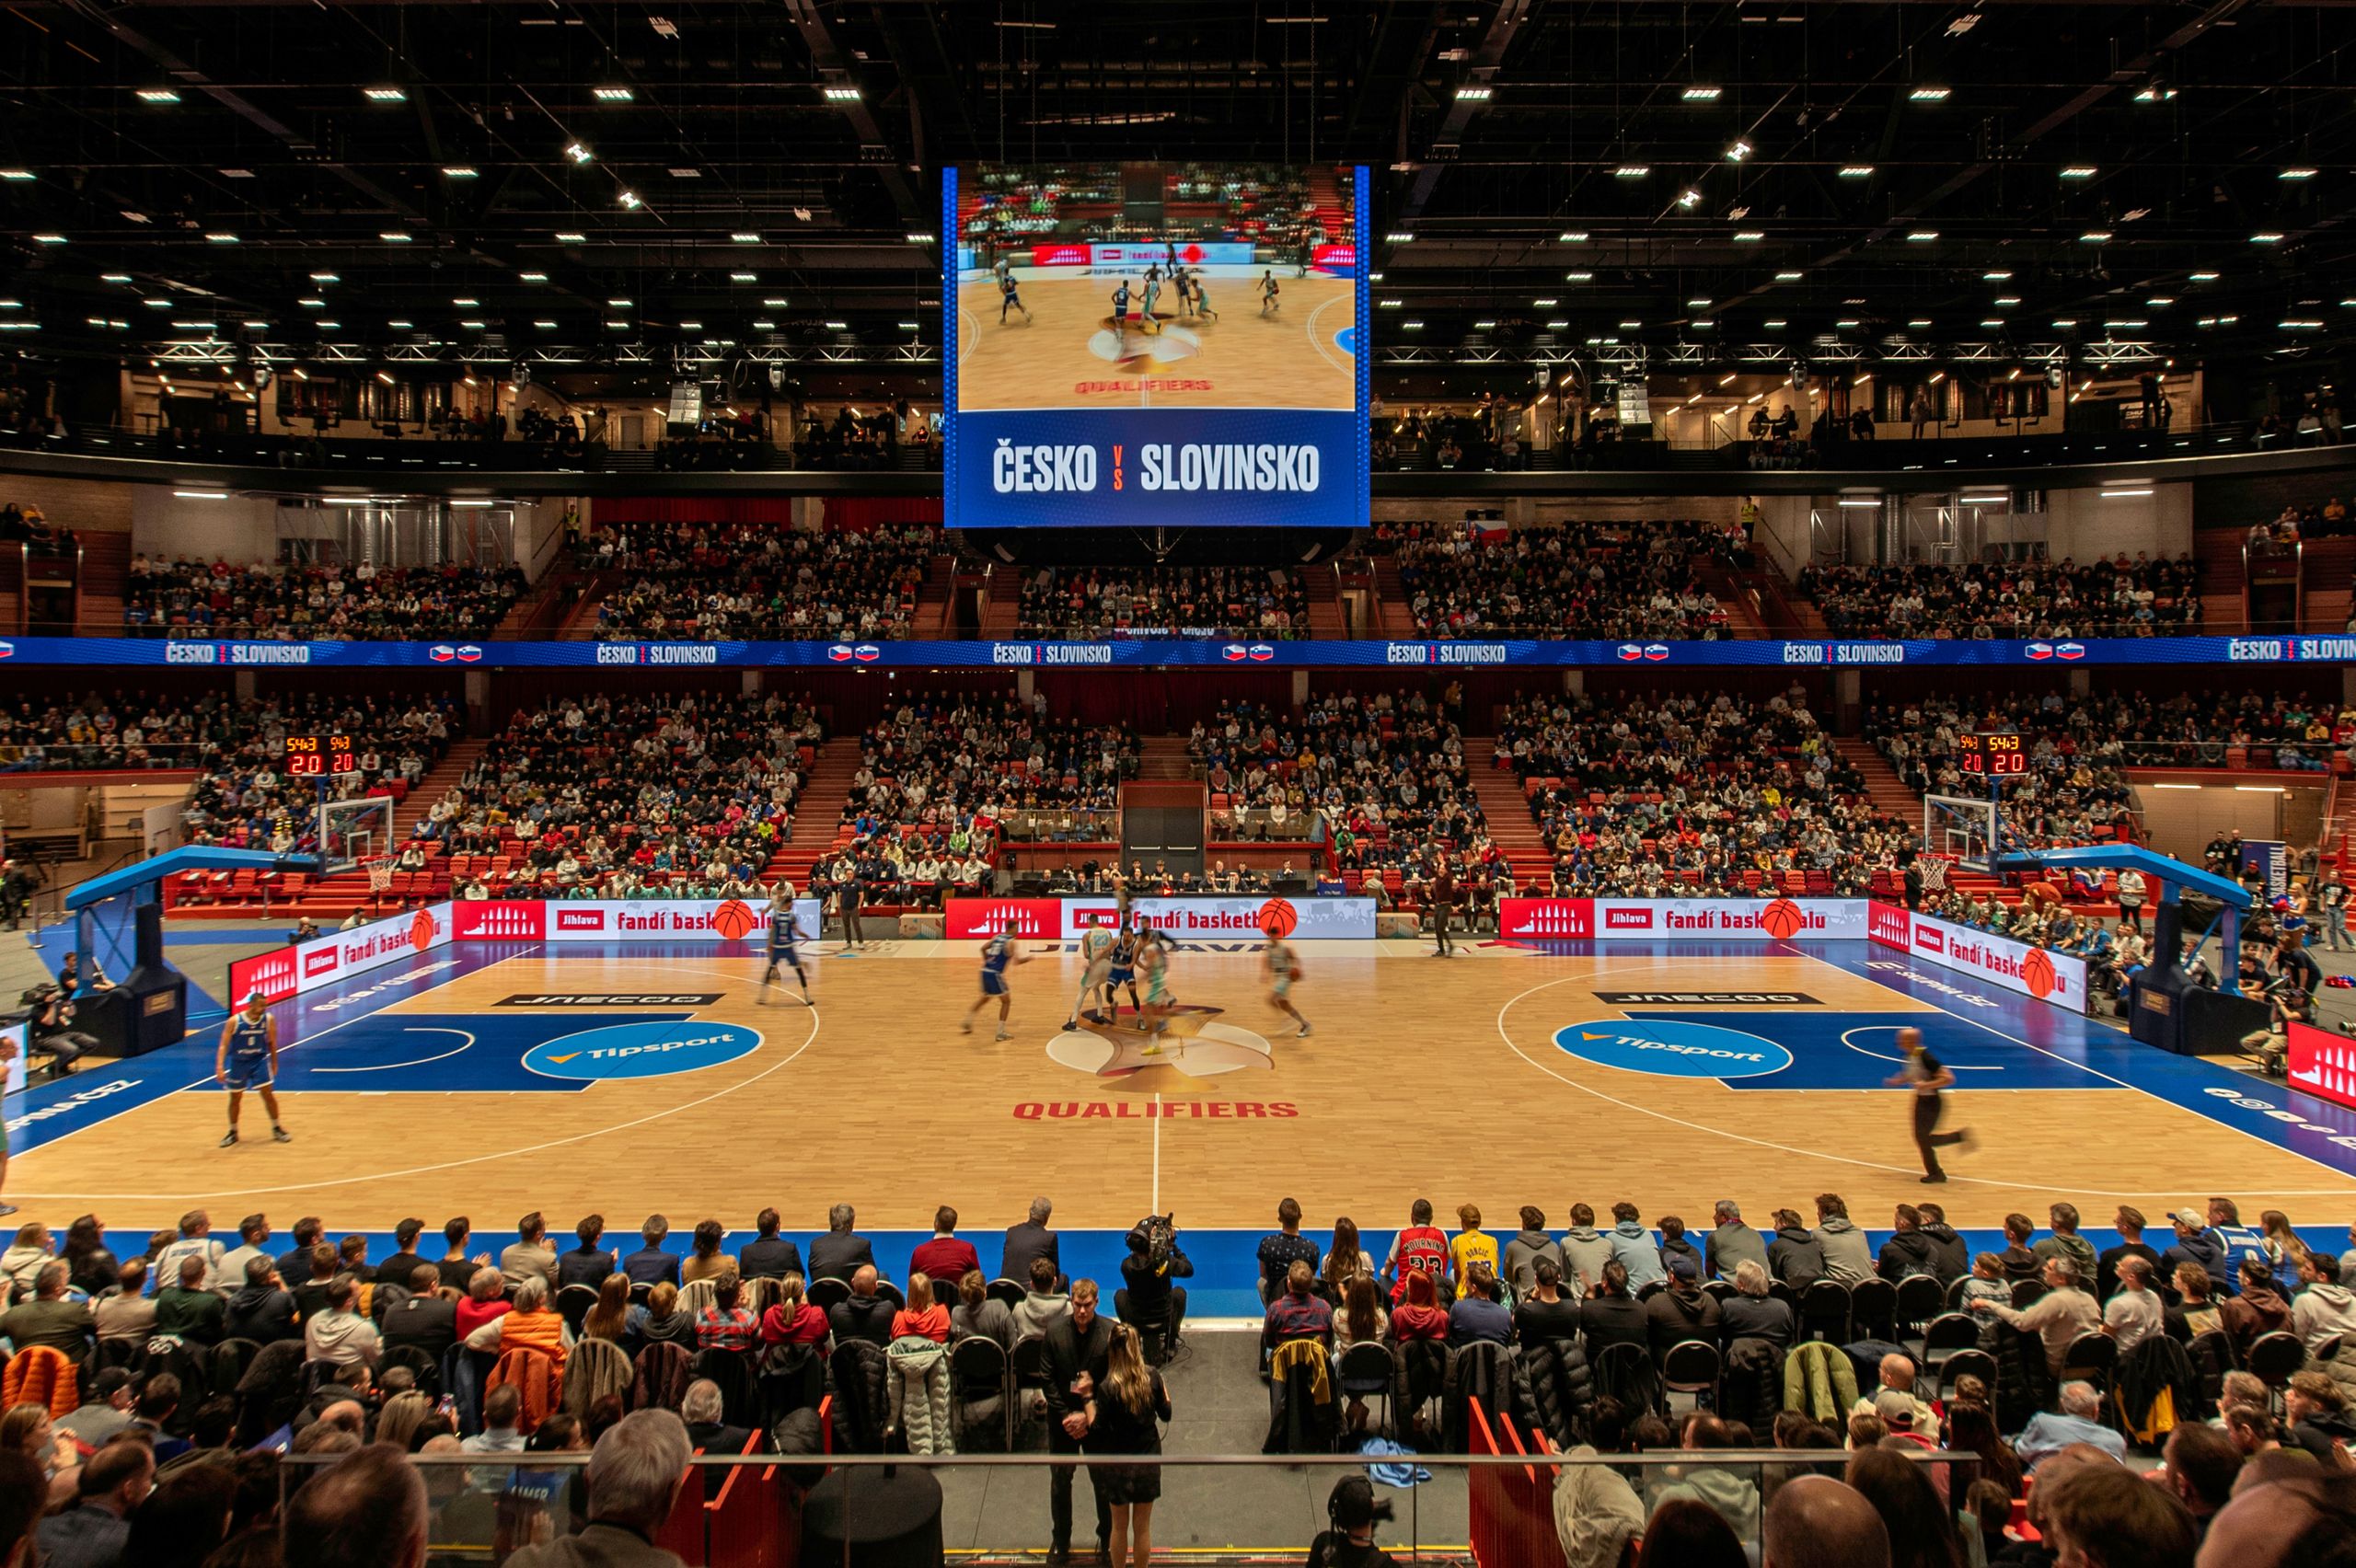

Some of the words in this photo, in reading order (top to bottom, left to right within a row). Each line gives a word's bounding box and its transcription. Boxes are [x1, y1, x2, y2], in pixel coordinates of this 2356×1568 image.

[1075, 379, 1214, 394] QUALIFIERS
[993, 438, 1097, 493] ČESKO
[1140, 444, 1320, 492] SLOVINSKO
[166, 641, 214, 663] ČESKO
[231, 645, 309, 663] SLOVINSKO
[597, 642, 636, 663] ČESKO
[650, 646, 716, 663] SLOVINSKO
[993, 642, 1032, 663] ČESKO
[1046, 645, 1111, 663] SLOVINSKO
[1387, 642, 1426, 663] ČESKO
[1440, 645, 1506, 663] SLOVINSKO
[1784, 641, 1823, 663] ČESKO
[1837, 645, 1903, 663] SLOVINSKO
[2229, 638, 2281, 660] ČESKO
[292, 755, 320, 773] 20
[333, 754, 352, 772] 20
[1964, 754, 1981, 772] 20
[1995, 754, 2023, 772] 20
[562, 915, 598, 926] Jihlava
[618, 911, 666, 929] fandí
[1079, 913, 1114, 924] Jiava
[1133, 909, 1182, 929] fndí
[1611, 913, 1647, 924] Jihlava
[1666, 910, 1715, 929] fandí
[1721, 910, 1826, 929] baskalu
[344, 937, 375, 965] fandí
[1948, 937, 1981, 965] fandí
[587, 1033, 735, 1059] Tipsport
[1614, 1035, 1766, 1062] Tipsport
[1012, 1101, 1299, 1120] QUALIFIERS
[1403, 1237, 1446, 1254] MOURNING
